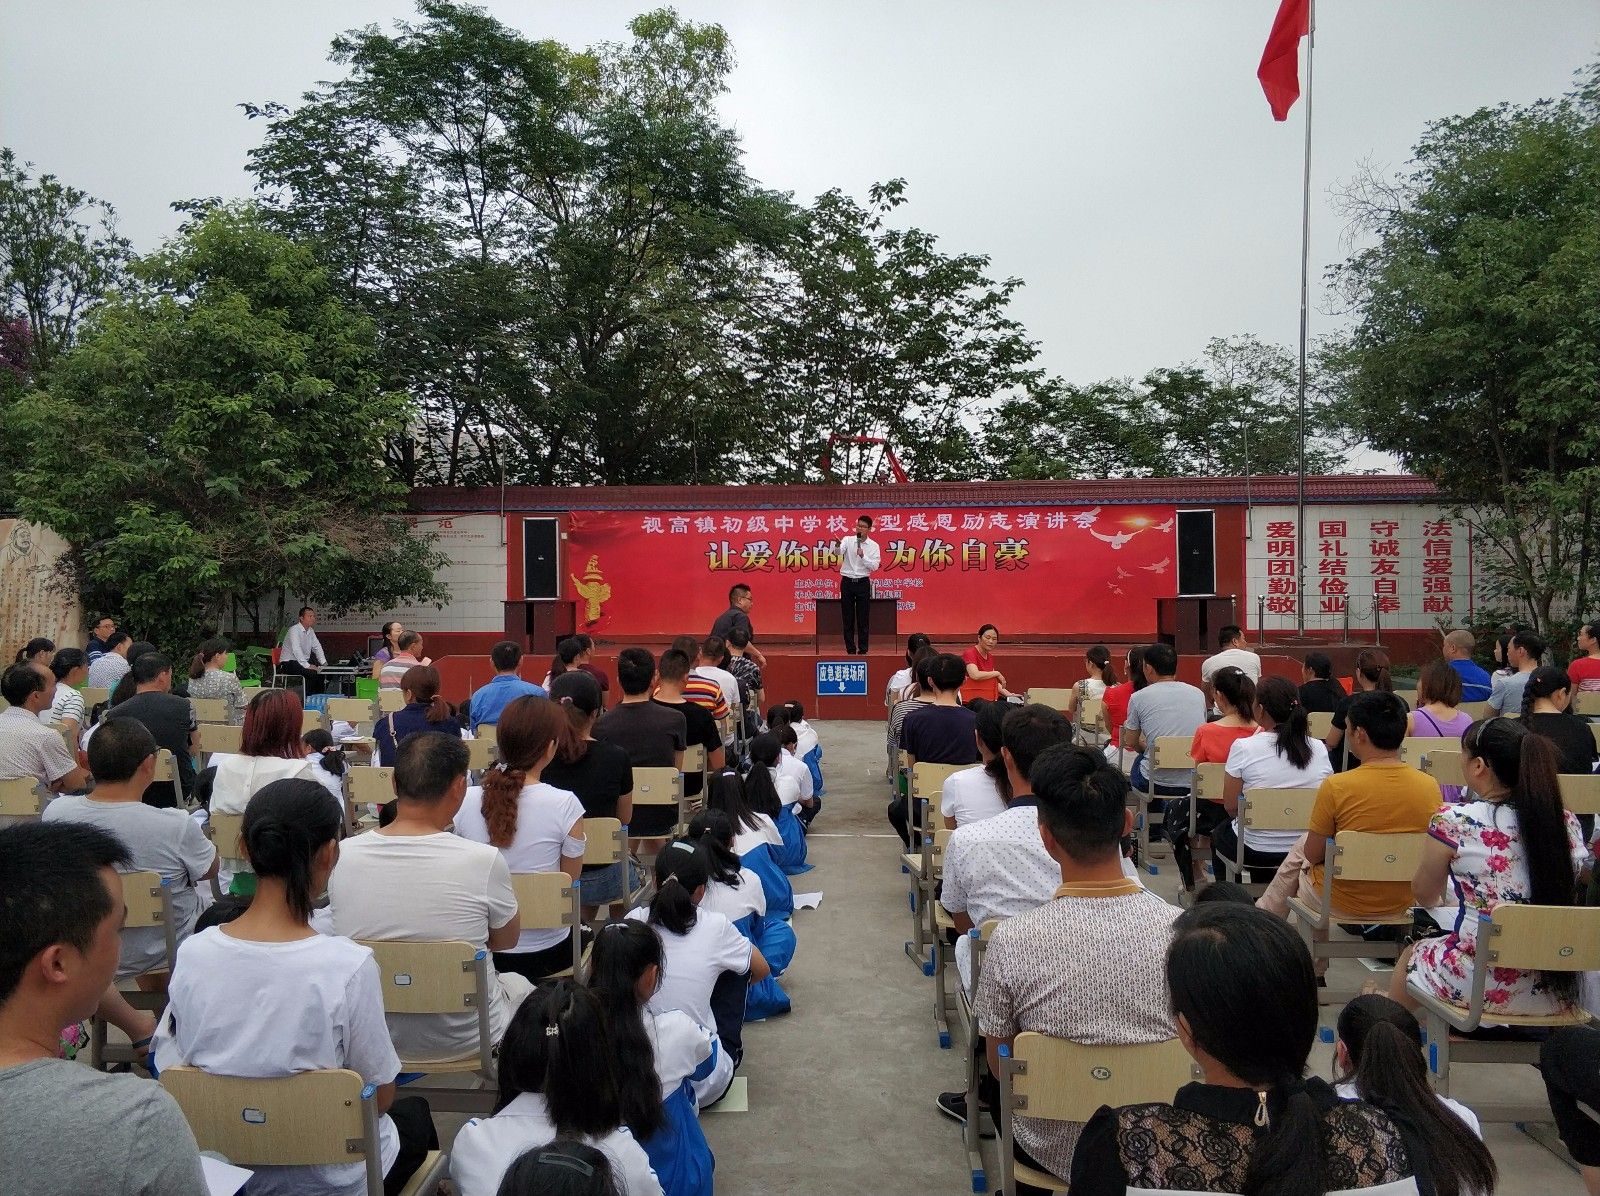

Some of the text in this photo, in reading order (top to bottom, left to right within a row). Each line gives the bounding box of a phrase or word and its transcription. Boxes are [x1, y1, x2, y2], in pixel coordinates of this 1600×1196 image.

[1266, 520, 1453, 539] 爱国守法
[705, 537, 1030, 573] 让爱你的为你自豪
[1267, 540, 1454, 557] 明礼诚信
[1267, 558, 1453, 576] 团结友爱
[1267, 577, 1453, 595] 勤俭自强
[1266, 596, 1454, 614] 敬业奉献
[820, 665, 864, 681] 应急避难场所
